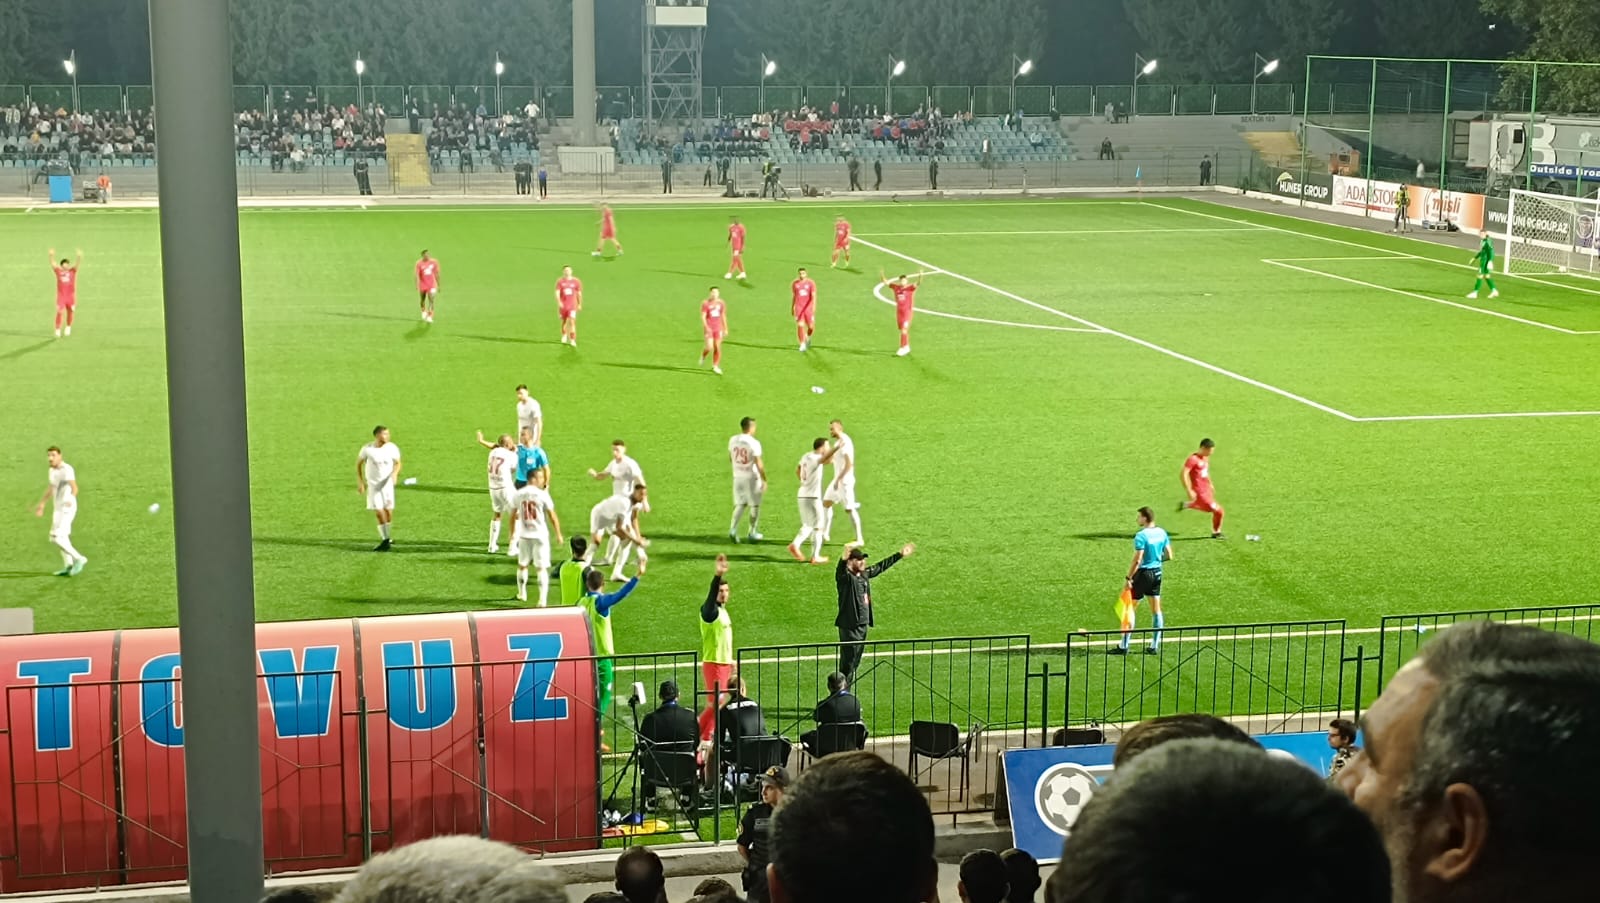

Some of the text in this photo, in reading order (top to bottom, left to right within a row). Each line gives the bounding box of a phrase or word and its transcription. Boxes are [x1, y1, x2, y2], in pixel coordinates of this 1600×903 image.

[1530, 164, 1573, 175] Outside
[1304, 184, 1329, 198] GROUP
[1432, 195, 1462, 213] misli
[733, 446, 749, 465] 29
[521, 500, 538, 521] 16
